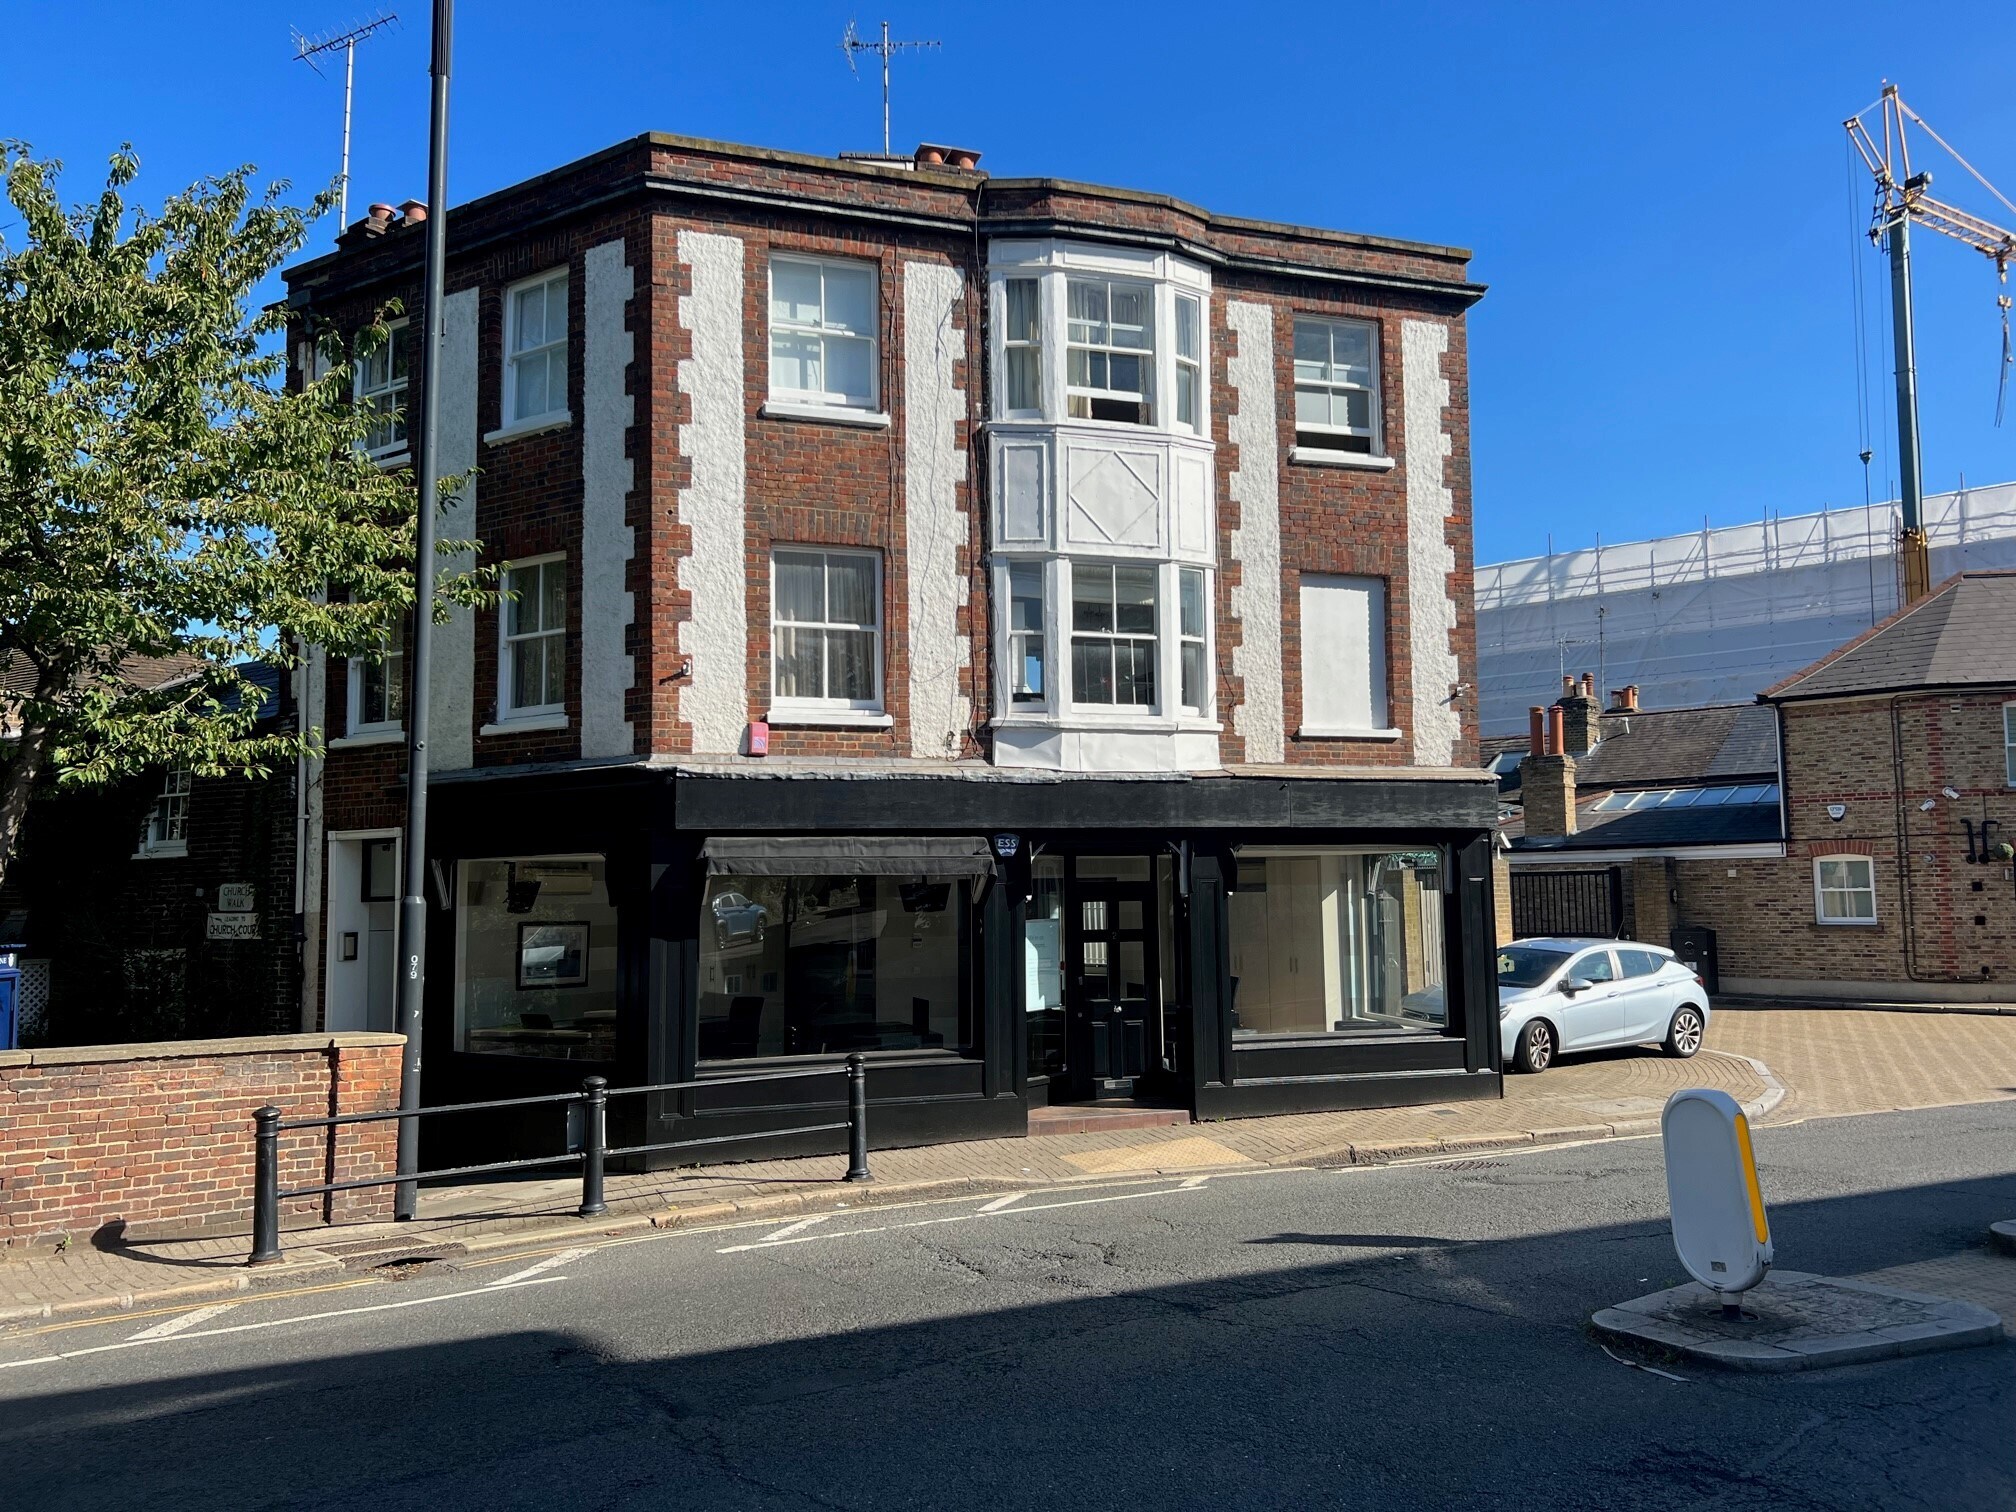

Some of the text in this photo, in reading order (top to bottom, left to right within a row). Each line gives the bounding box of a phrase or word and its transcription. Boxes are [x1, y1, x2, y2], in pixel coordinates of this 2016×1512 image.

[998, 839, 1016, 847] ESS
[223, 887, 251, 896] CHURCH
[226, 898, 244, 907] WALK
[209, 925, 235, 934] CHURCH
